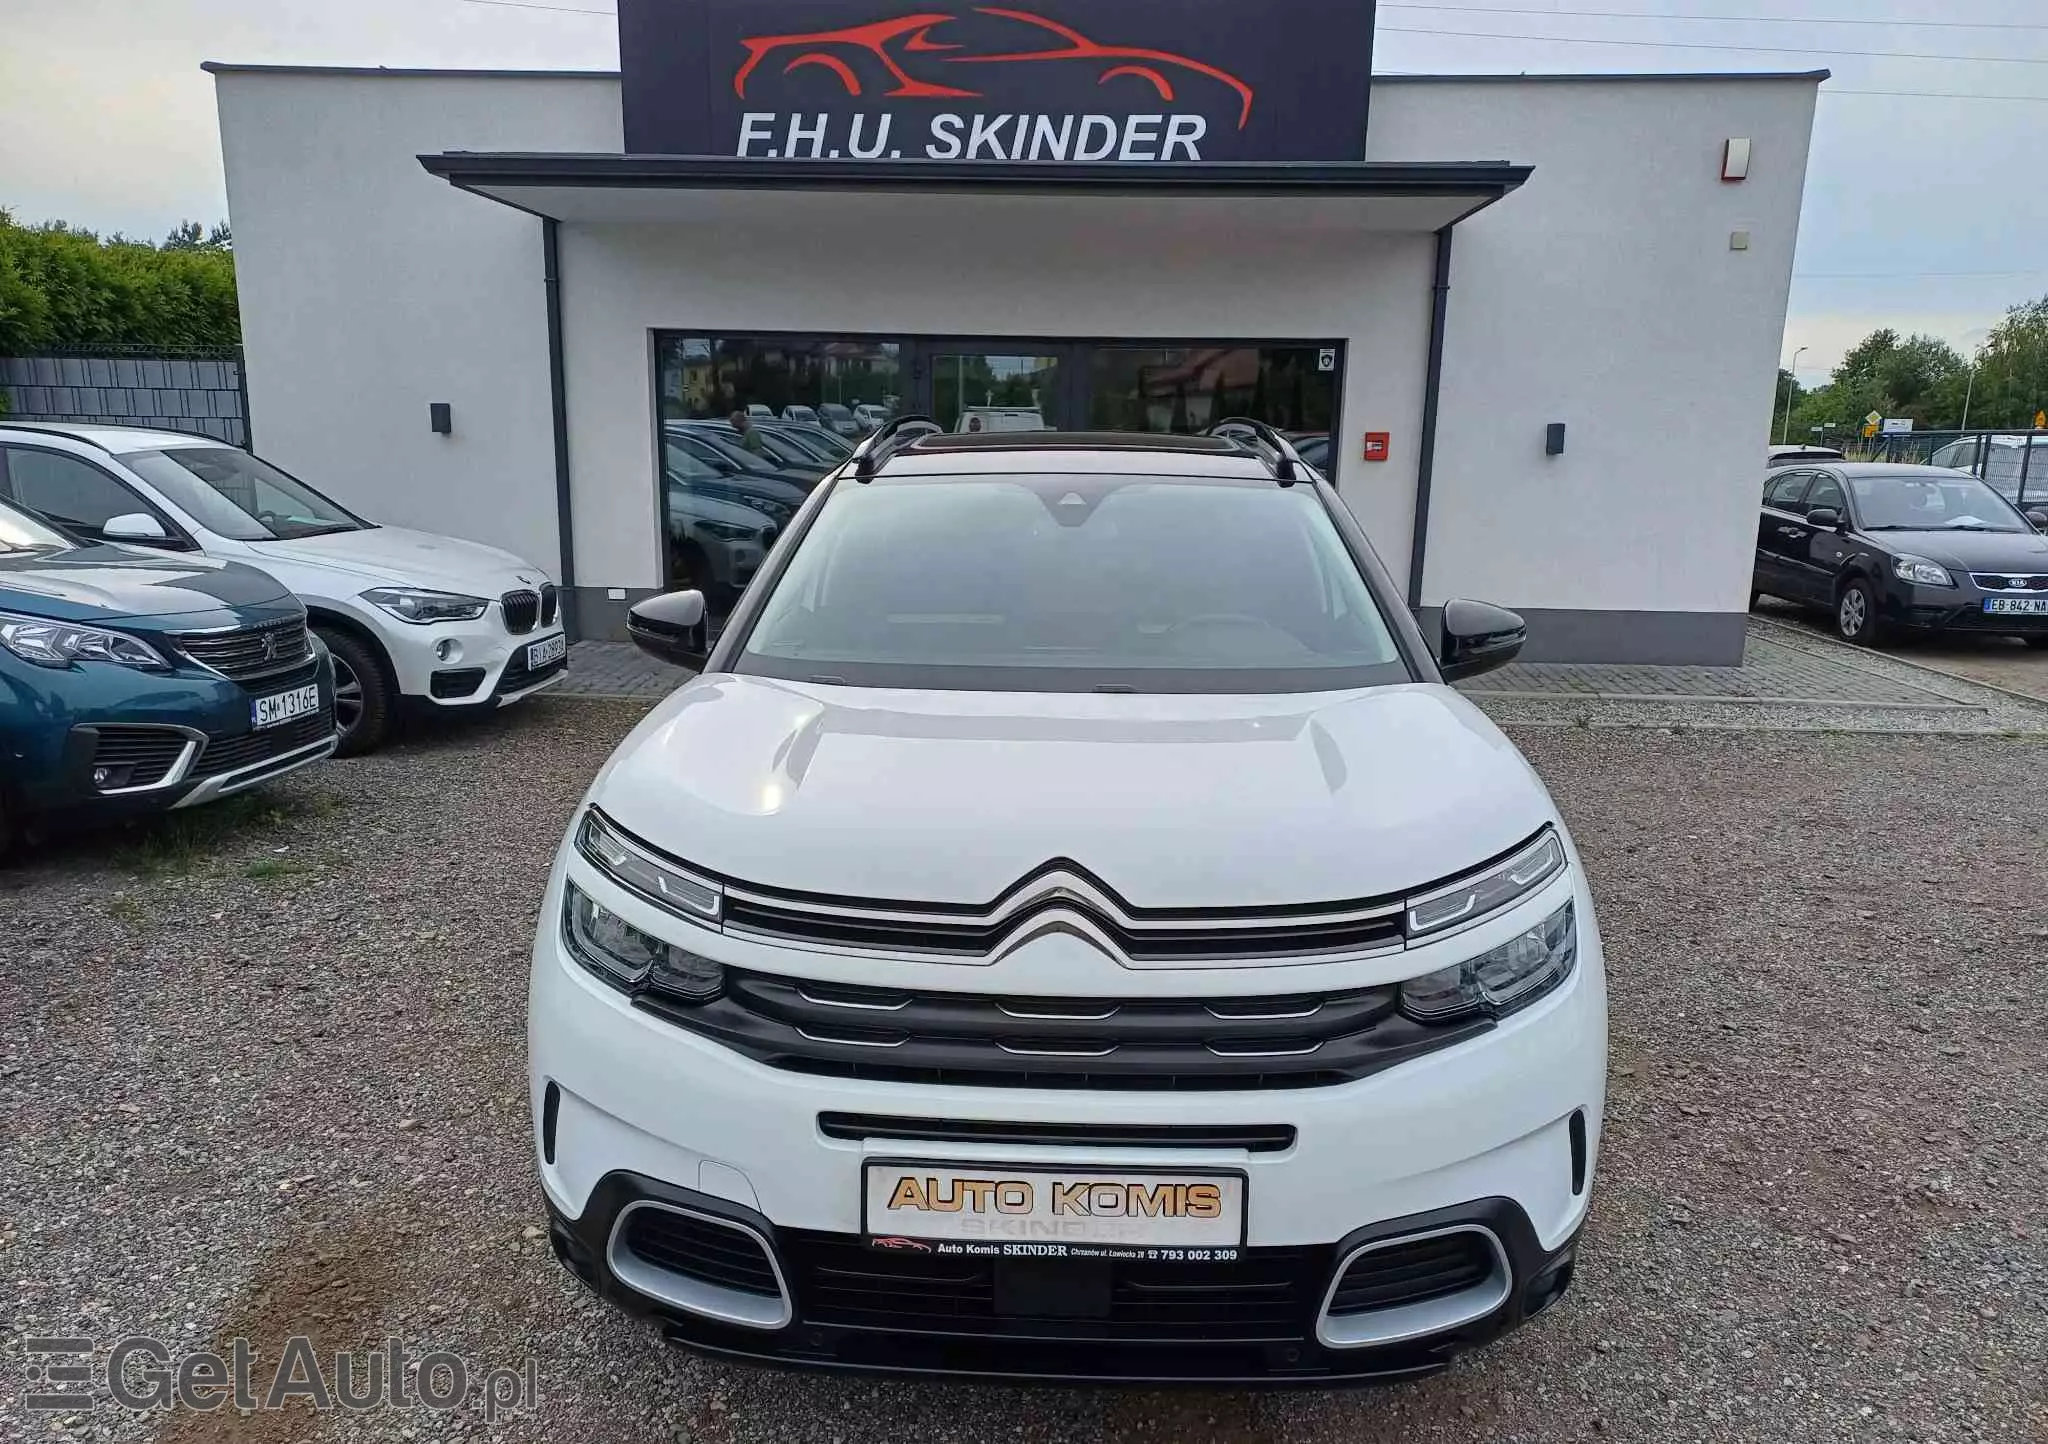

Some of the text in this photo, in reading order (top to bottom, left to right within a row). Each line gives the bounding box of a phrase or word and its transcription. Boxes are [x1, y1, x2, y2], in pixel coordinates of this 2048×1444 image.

[736, 112, 1207, 161] F.H.U. SKINDER
[259, 697, 277, 722] SM
[282, 686, 316, 716] 1316E
[887, 1176, 1221, 1219] AUTO KOMIS
[938, 1243, 963, 1254] Auto
[966, 1244, 1000, 1255] Komis
[1003, 1244, 1068, 1257] SKINDER
[1160, 1249, 1184, 1261] 793
[1187, 1249, 1211, 1261] 002
[1214, 1249, 1238, 1261] 309
